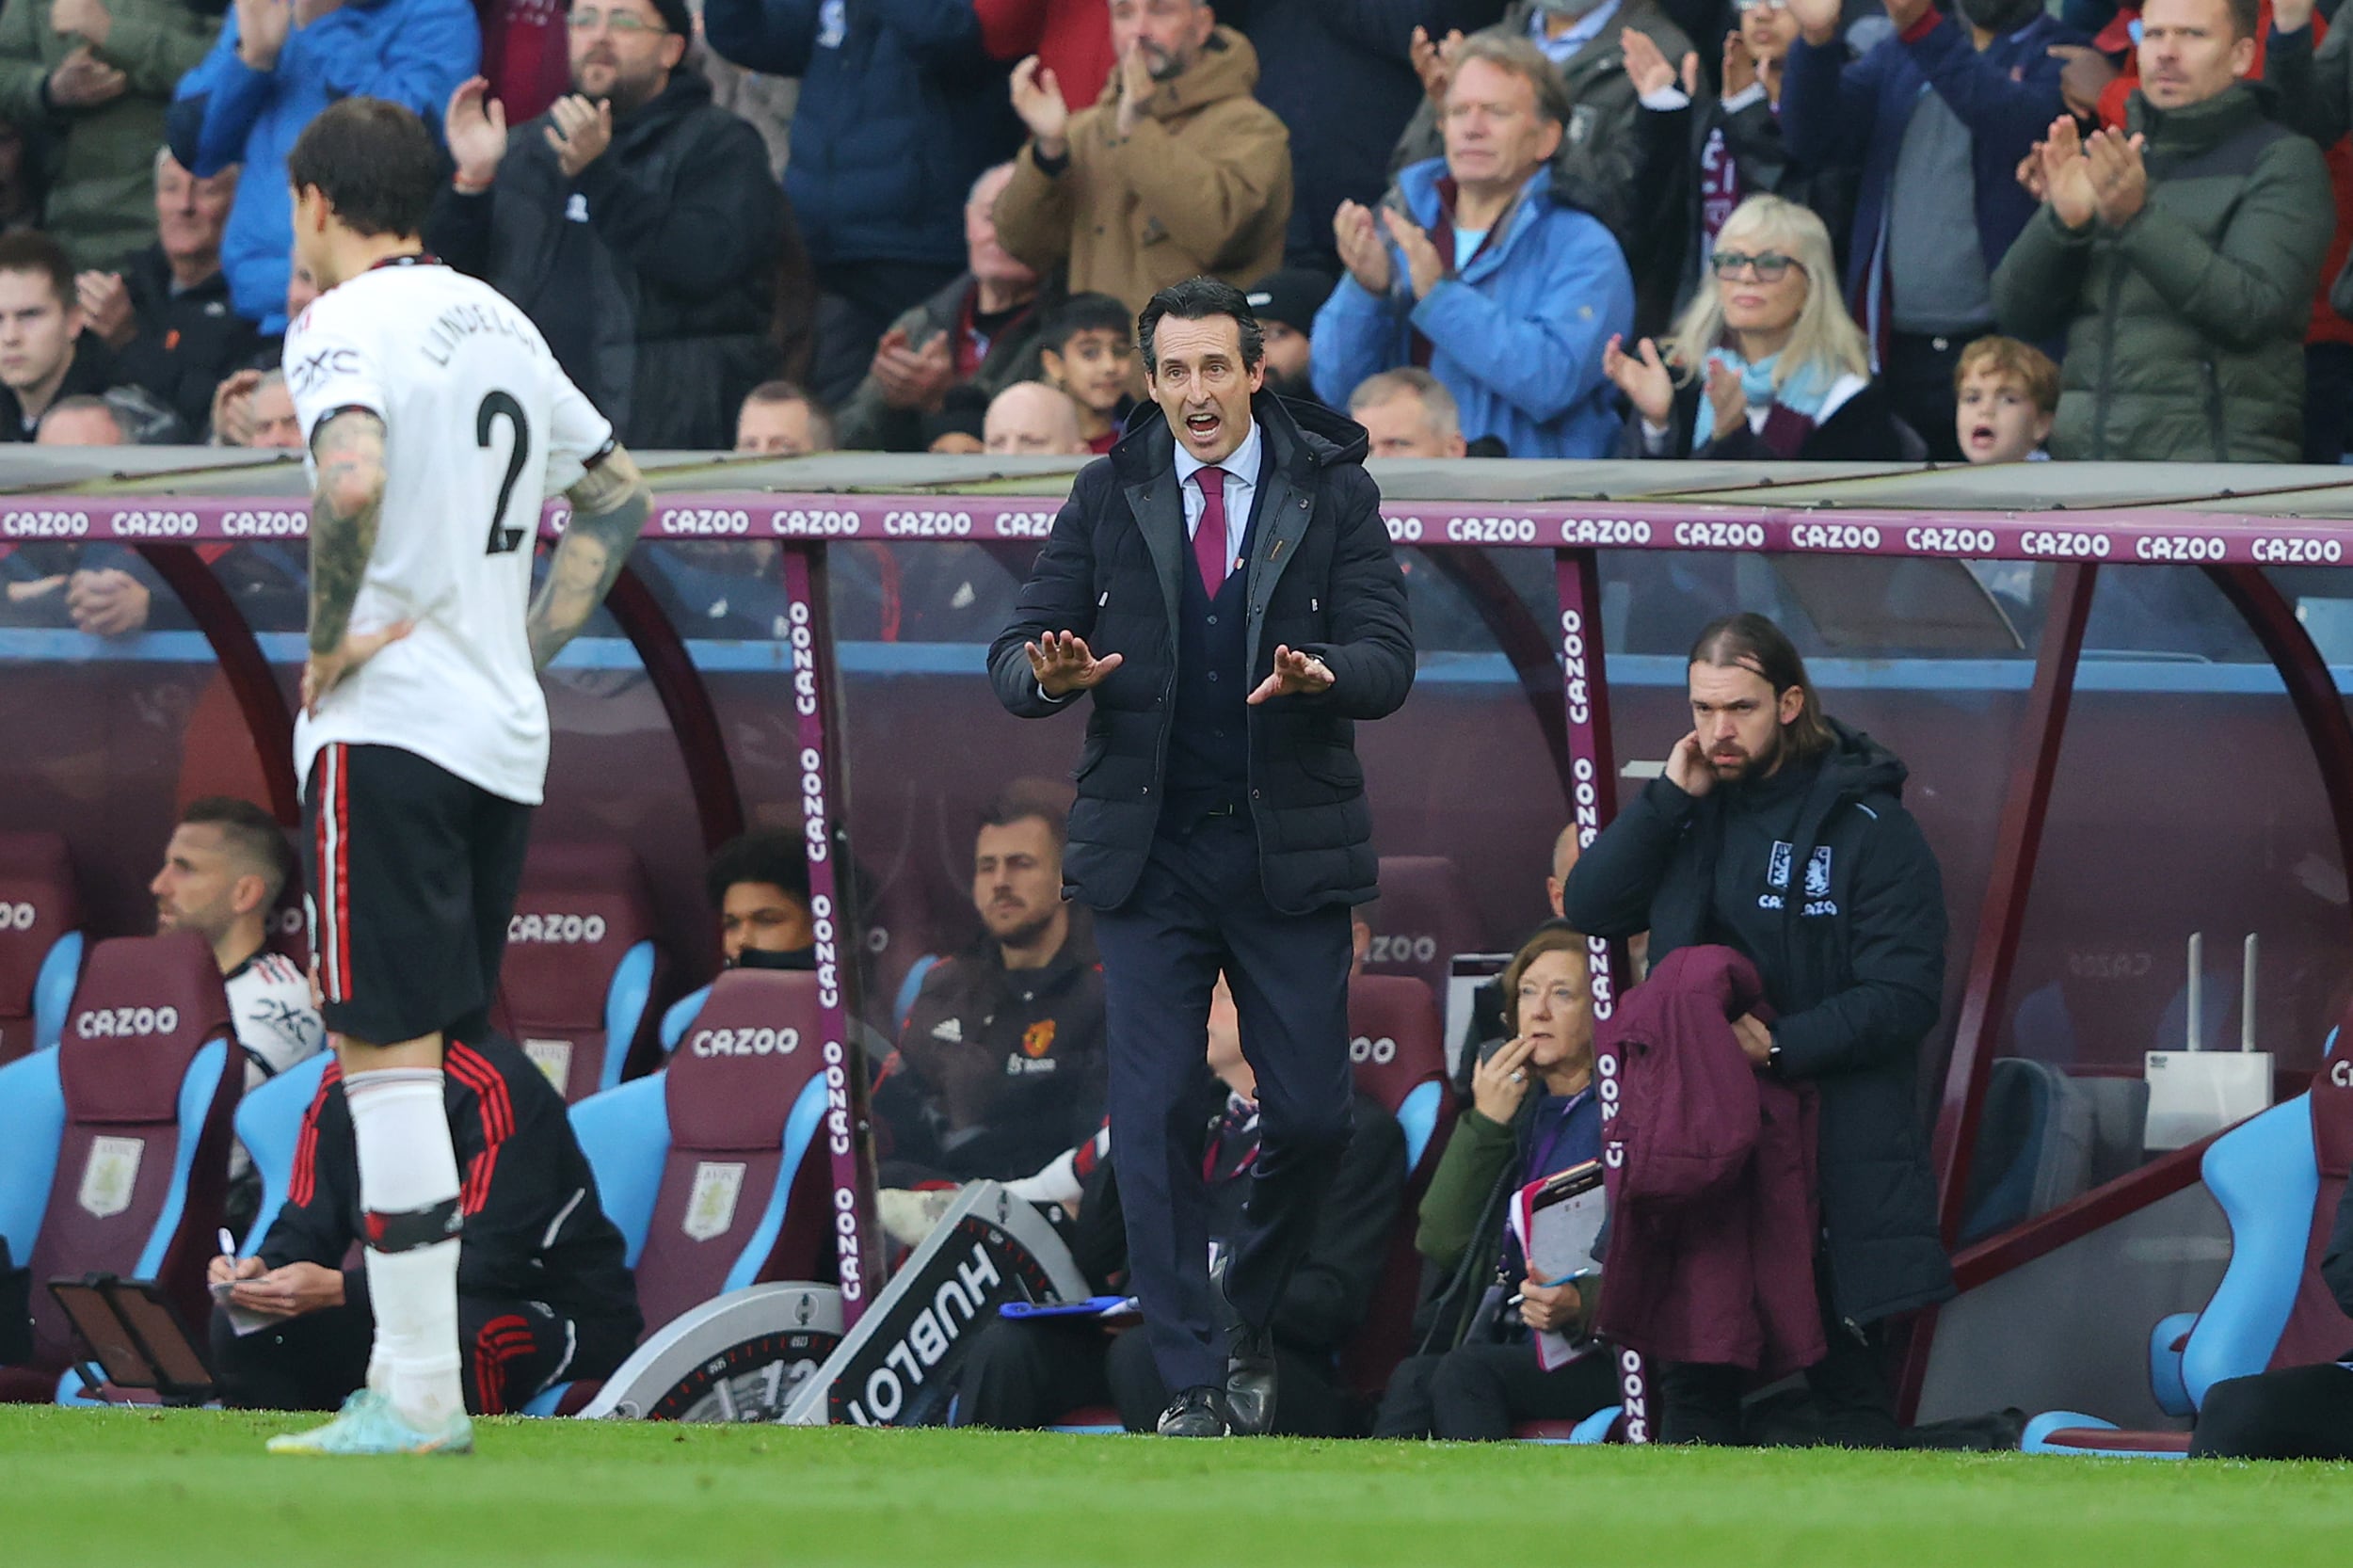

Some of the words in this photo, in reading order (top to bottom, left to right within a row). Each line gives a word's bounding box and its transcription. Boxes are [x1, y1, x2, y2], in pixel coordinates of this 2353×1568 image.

[477, 391, 530, 554] 2
[3, 511, 89, 536] CAZOO
[111, 511, 199, 536] CAZOO
[220, 511, 308, 536] CAZOO
[662, 509, 749, 534] CAZOO
[772, 510, 860, 535] CAZOO
[883, 511, 971, 536] CAZOO
[995, 512, 1057, 536] CAZ
[1447, 517, 1536, 541] CAZOO
[1561, 520, 1651, 544] CAZOO
[1674, 522, 1765, 546] CAZOO
[1792, 525, 1881, 549] CAZOO
[1906, 528, 1995, 552] CAZOO
[2021, 531, 2110, 556] CAZOO
[2136, 536, 2226, 560] CAZOO
[2251, 538, 2342, 562] CAZOO
[789, 601, 816, 715] CAZOO
[1561, 610, 1589, 724] CAZOO
[800, 747, 826, 862] CAZOO
[1573, 758, 1597, 849] AZOO
[507, 913, 606, 943] CAZOO
[811, 894, 839, 1008] CAZOO
[1363, 936, 1436, 964] ZOO
[77, 1006, 179, 1040] CAZOO
[1588, 936, 1612, 1020] CAZO
[692, 1027, 800, 1058] CAZOO
[824, 1041, 850, 1155] CAZOO
[1598, 1054, 1624, 1169] CZOO
[835, 1187, 861, 1302] CAZOO
[1623, 1349, 1647, 1444] AZOO
